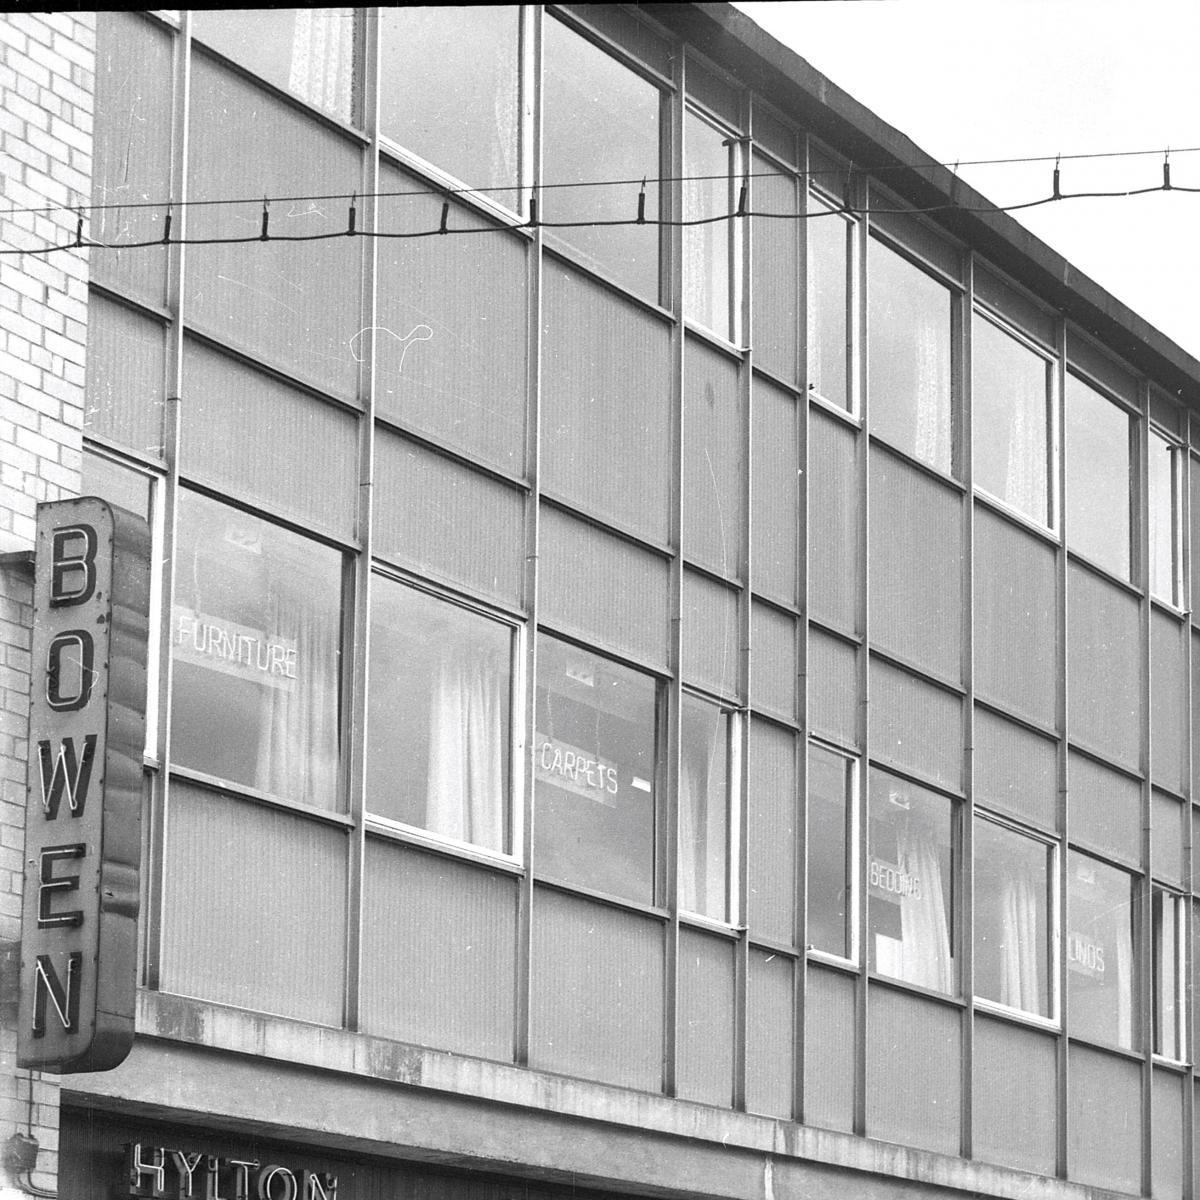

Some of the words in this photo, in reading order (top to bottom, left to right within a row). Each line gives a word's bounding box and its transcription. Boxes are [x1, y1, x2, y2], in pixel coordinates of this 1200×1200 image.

[178, 615, 298, 680] FURNITURE
[34, 522, 97, 1039] BOWEN
[541, 742, 618, 794] CARPETS
[871, 862, 921, 900] BEDDING
[1068, 936, 1105, 971] LINDS
